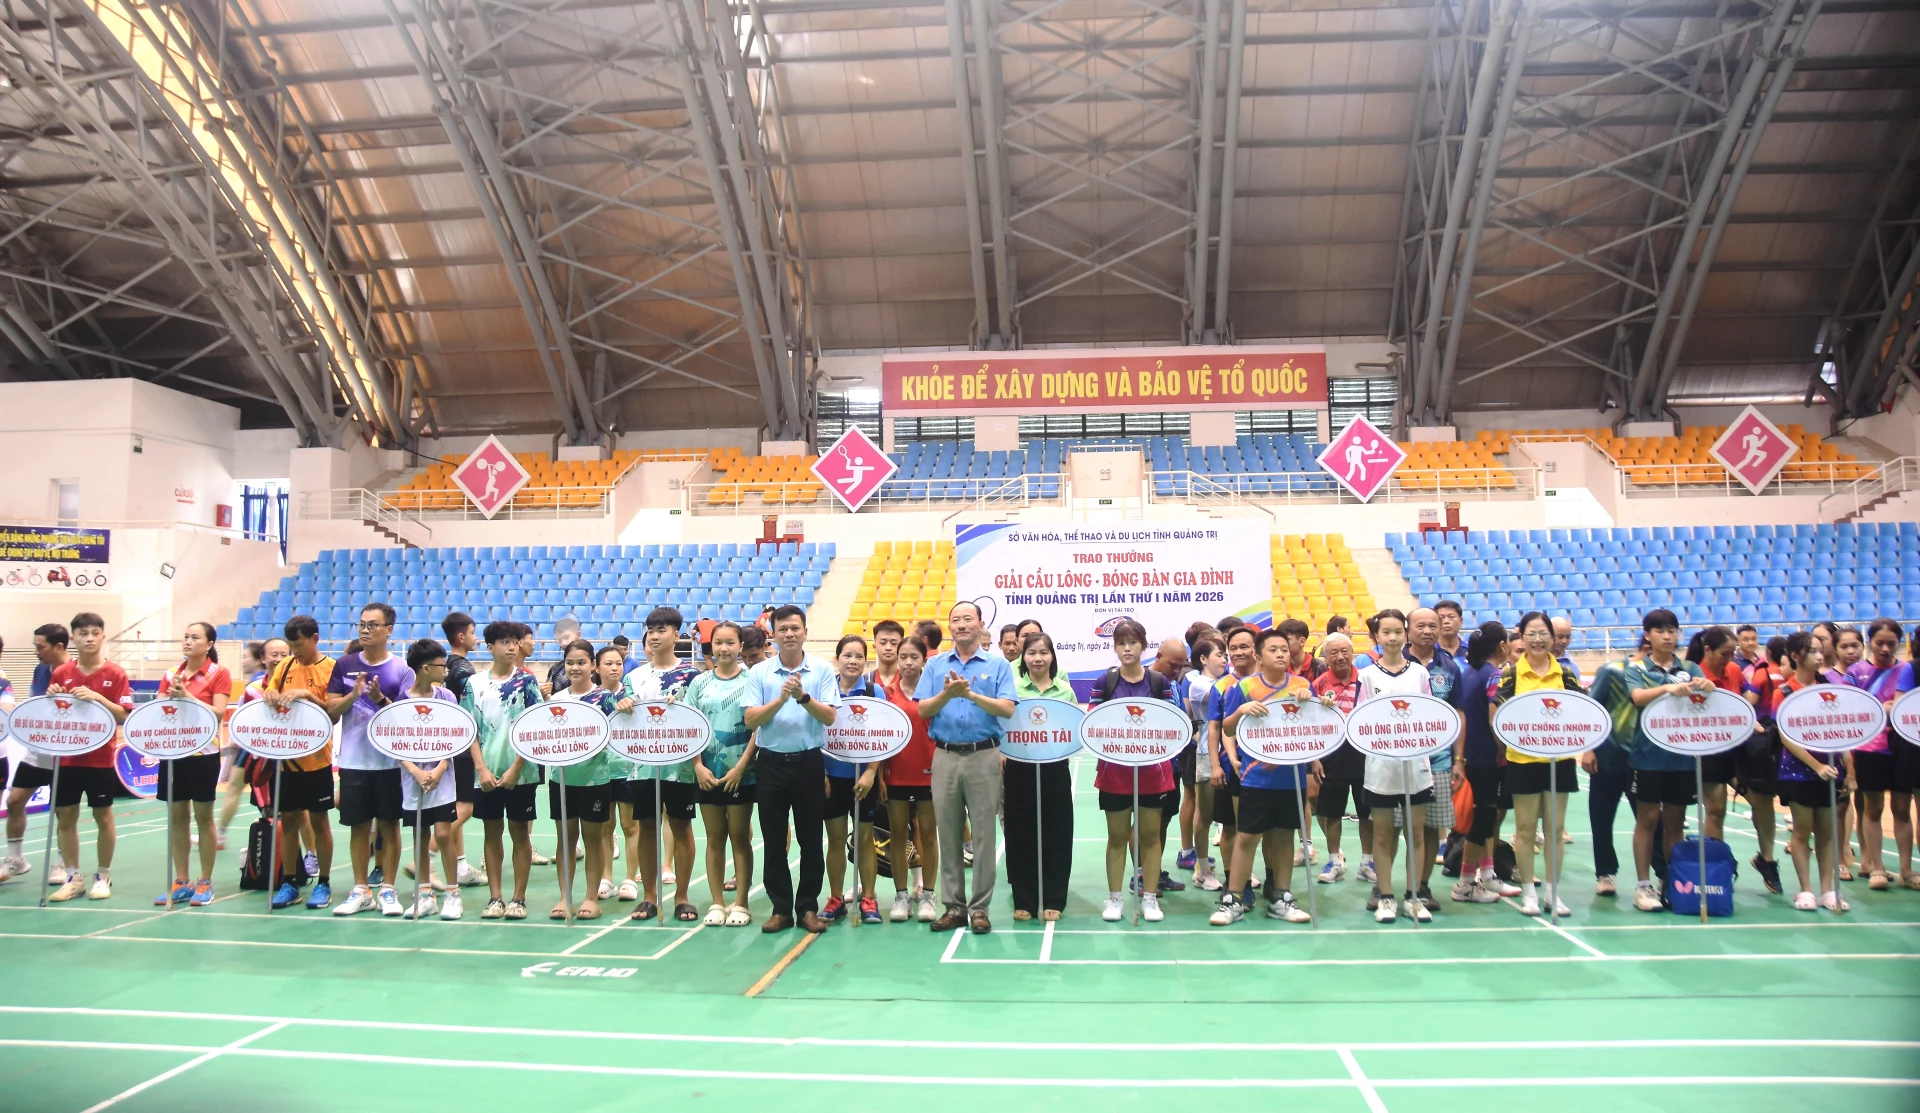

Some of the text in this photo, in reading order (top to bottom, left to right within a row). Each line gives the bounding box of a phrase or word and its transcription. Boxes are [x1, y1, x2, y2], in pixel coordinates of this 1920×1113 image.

[902, 359, 1308, 404] KHỎE ĐỂ XÂY DỰNG VÀ BẢO VỆ TỔ QUỐC
[1008, 531, 1020, 542] SỞ
[1022, 532, 1039, 541] VĂN
[1042, 532, 1062, 542] HÓA,
[1065, 529, 1078, 540] THỂ
[1105, 530, 1116, 540] VÀ
[1132, 532, 1150, 542] LỊCH
[1153, 529, 1171, 539] TỈNH
[1173, 528, 1204, 539] QUẢNG
[1206, 531, 1218, 541] TRỊ
[1073, 549, 1154, 563] TRAO THƯỞNG
[995, 569, 1023, 588] GIẢI
[1026, 567, 1053, 588] CẦU
[1057, 569, 1092, 588] LÔNG
[1103, 569, 1138, 587] BÓNG
[1142, 568, 1170, 586] BÀN
[1174, 572, 1197, 586] GIA
[1200, 567, 1234, 585] ĐÌNH
[1005, 592, 1032, 604] TỈNH
[1036, 591, 1076, 605] QUẢNG
[1080, 594, 1098, 606] TRỊ
[1129, 591, 1153, 603] THỨ
[1156, 593, 1159, 602] I
[1164, 590, 1191, 602] NĂM
[1195, 592, 1224, 602] 2026
[1057, 642, 1076, 651] Quảng
[1086, 643, 1101, 652] ngày
[131, 729, 141, 737] ĐÔI
[144, 729, 152, 738] VỢ
[179, 727, 201, 735] (NHÓM
[204, 726, 210, 734] 1)
[237, 725, 249, 733] ĐÔI
[251, 726, 260, 735] VỢ
[290, 728, 315, 737] (NHÓM
[317, 730, 325, 738] 2)
[828, 726, 903, 738] VỢ CHỒNG (NHÓM 1)
[1359, 719, 1447, 735] ĐÔI ÔNG (BÀ) VÀ CHÁU
[1502, 722, 1516, 731] ĐÔI
[1519, 723, 1529, 733] VỢ
[1563, 723, 1591, 732] (NHÓM
[1593, 724, 1602, 732] 2)
[29, 732, 49, 743] MÔN:
[69, 733, 90, 745] LÔNG
[1006, 728, 1072, 746] TRỌNG TÀI
[1519, 734, 1585, 746] MÔN: BÓNG BÀN
[1668, 730, 1732, 743] MÔN: BÓNG BÀN
[1802, 727, 1863, 741] MÔN: BÓNG BÀN
[144, 738, 161, 750] MÔN:
[178, 737, 197, 748] LÔNG
[251, 736, 269, 747] MÔN:
[288, 737, 309, 749] LÔNG
[391, 738, 452, 751] MÔN: CẦU LÔNG
[532, 744, 550, 755] MÔN:
[569, 741, 589, 752] LÔNG
[627, 741, 688, 754] MÔN: CẦU LÔNG
[828, 739, 888, 751] MÔN: BÓNG BÀN
[1102, 742, 1167, 754] MÔN: BÓNG BÀN
[1262, 739, 1325, 753] MÔN: BÓNG BÀN
[1371, 736, 1437, 750] MÔN: BÓNG BÀN
[1694, 884, 1723, 895] BUTERFLY
